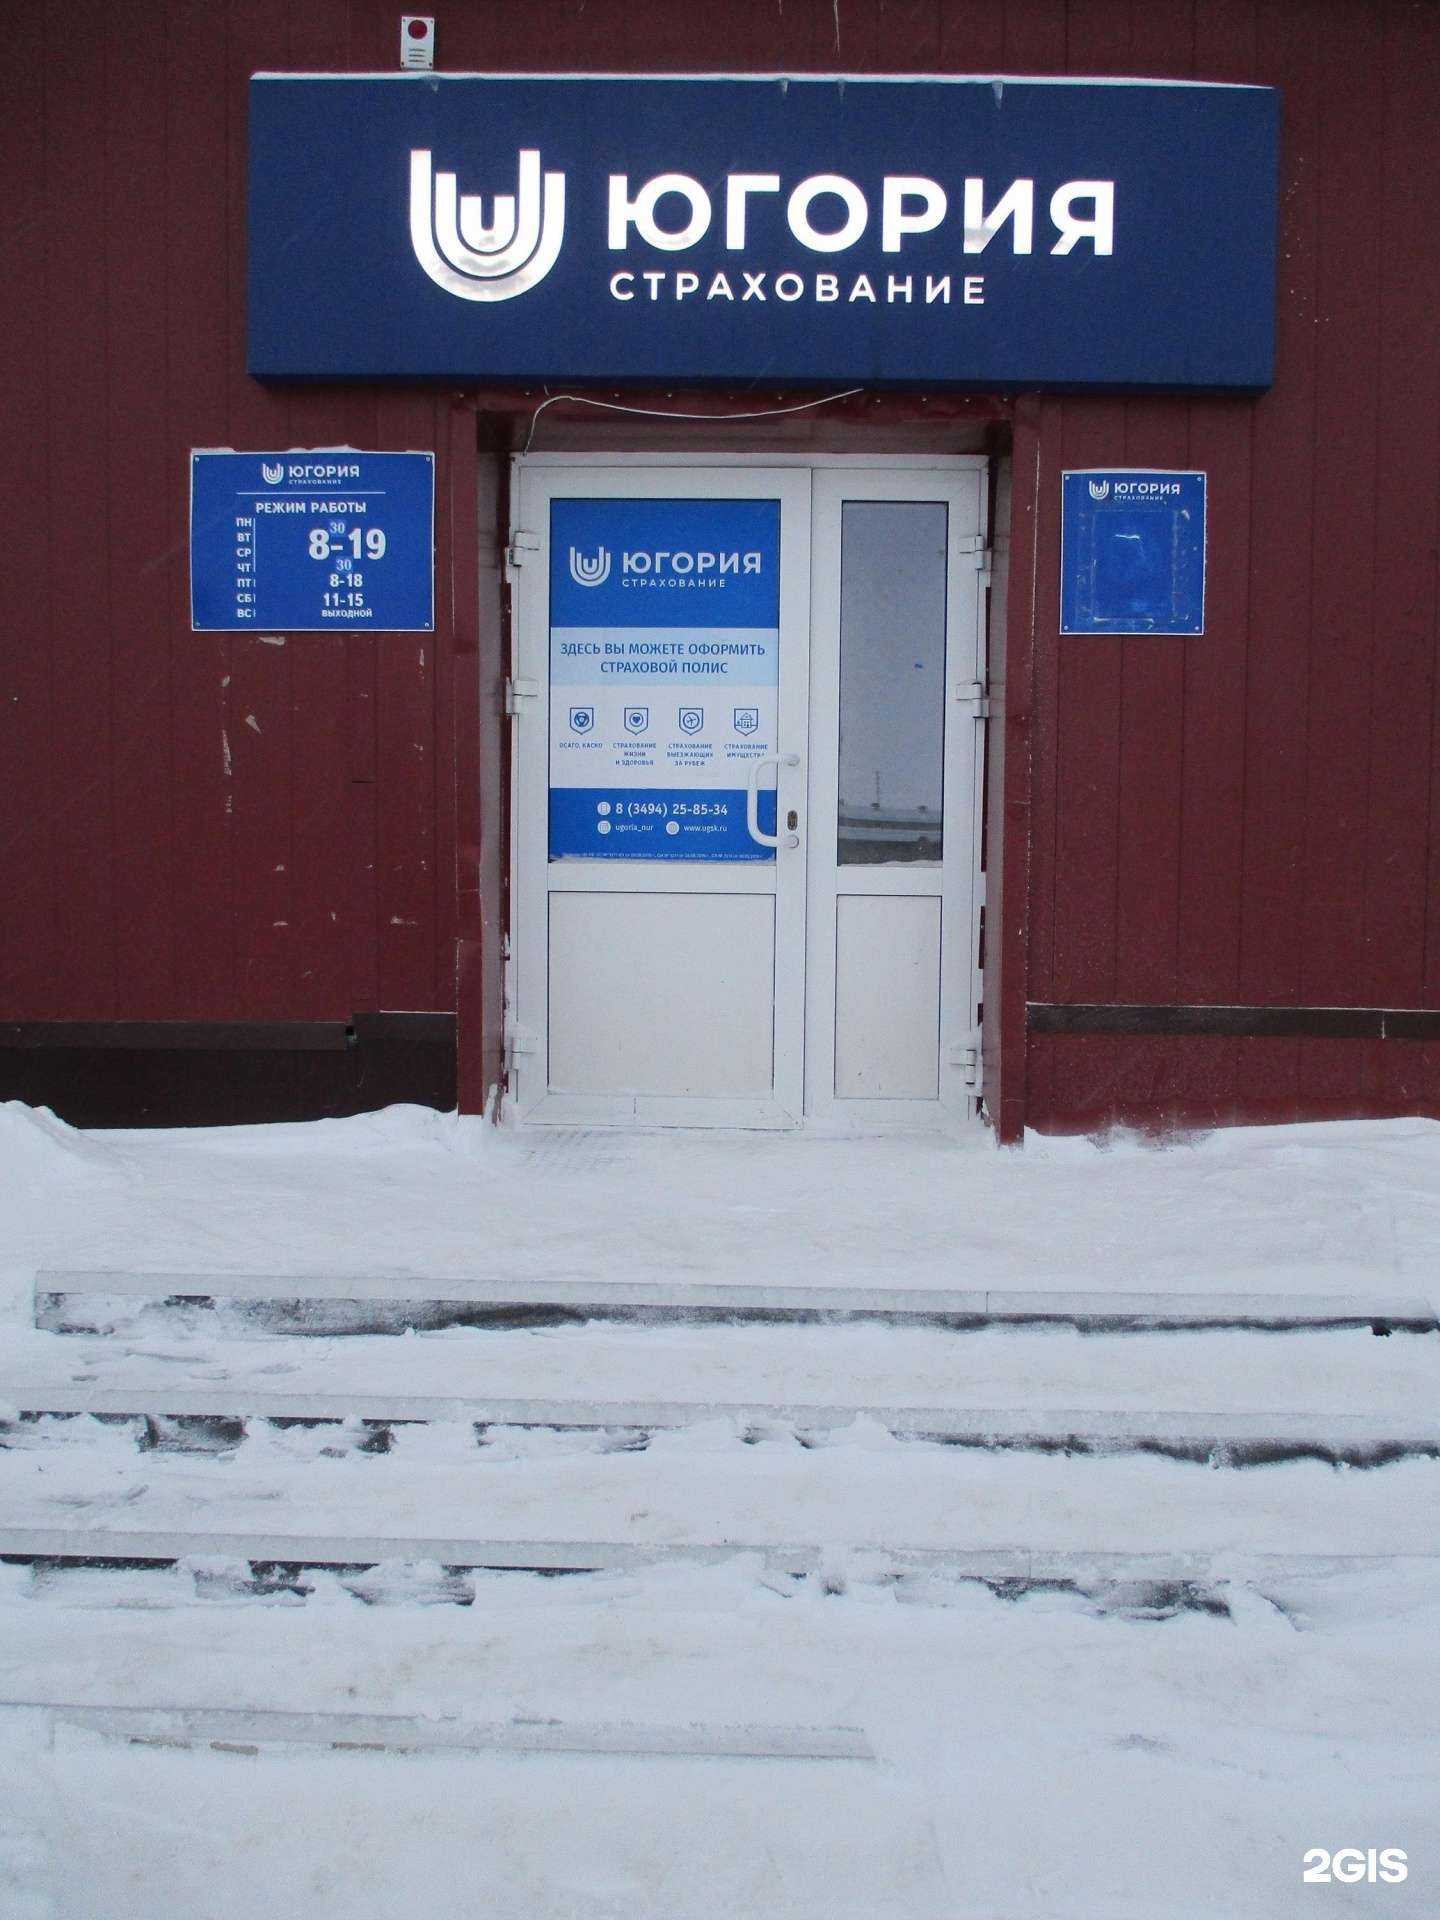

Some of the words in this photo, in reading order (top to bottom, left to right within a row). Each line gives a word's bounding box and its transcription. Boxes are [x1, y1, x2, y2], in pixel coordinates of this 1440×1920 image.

[607, 173, 1116, 257] ЮГОРИЯ
[608, 271, 986, 305] СТРАХОВАНИЕ
[288, 465, 360, 478] ЮГОРИЯ
[1114, 482, 1181, 495] ЮГОРИЯ
[255, 502, 307, 514] РЕЖИМ
[311, 502, 367, 513] РАБОТЫ
[236, 517, 252, 527] ПН
[329, 521, 346, 534] 30
[237, 532, 252, 542] ВТ
[308, 528, 387, 560] 8-19
[236, 548, 252, 558] СР
[237, 563, 252, 573] ЧТ
[335, 558, 353, 571] 30
[622, 551, 762, 575] ЮГОРИЯ
[236, 578, 252, 588] ПТ
[329, 573, 363, 588] 8-18
[621, 578, 727, 589] СТРАХОВАНИЕ
[236, 593, 252, 603] СБ
[323, 592, 364, 607] 11-15
[236, 608, 252, 618] ВС
[560, 642, 601, 657] ЗДЕСЬ
[604, 643, 625, 655] ВЫ
[629, 643, 685, 655] МОЖЕТЕ
[688, 643, 766, 657] ОФОРМИТЬ
[600, 659, 678, 673] СТРАХОВОЙ
[681, 662, 729, 674] ПОЛИС
[615, 803, 624, 815] 8
[627, 802, 669, 817] (3494)
[672, 803, 728, 815] 25-85-34
[683, 824, 728, 833] www.ugsk.ru
